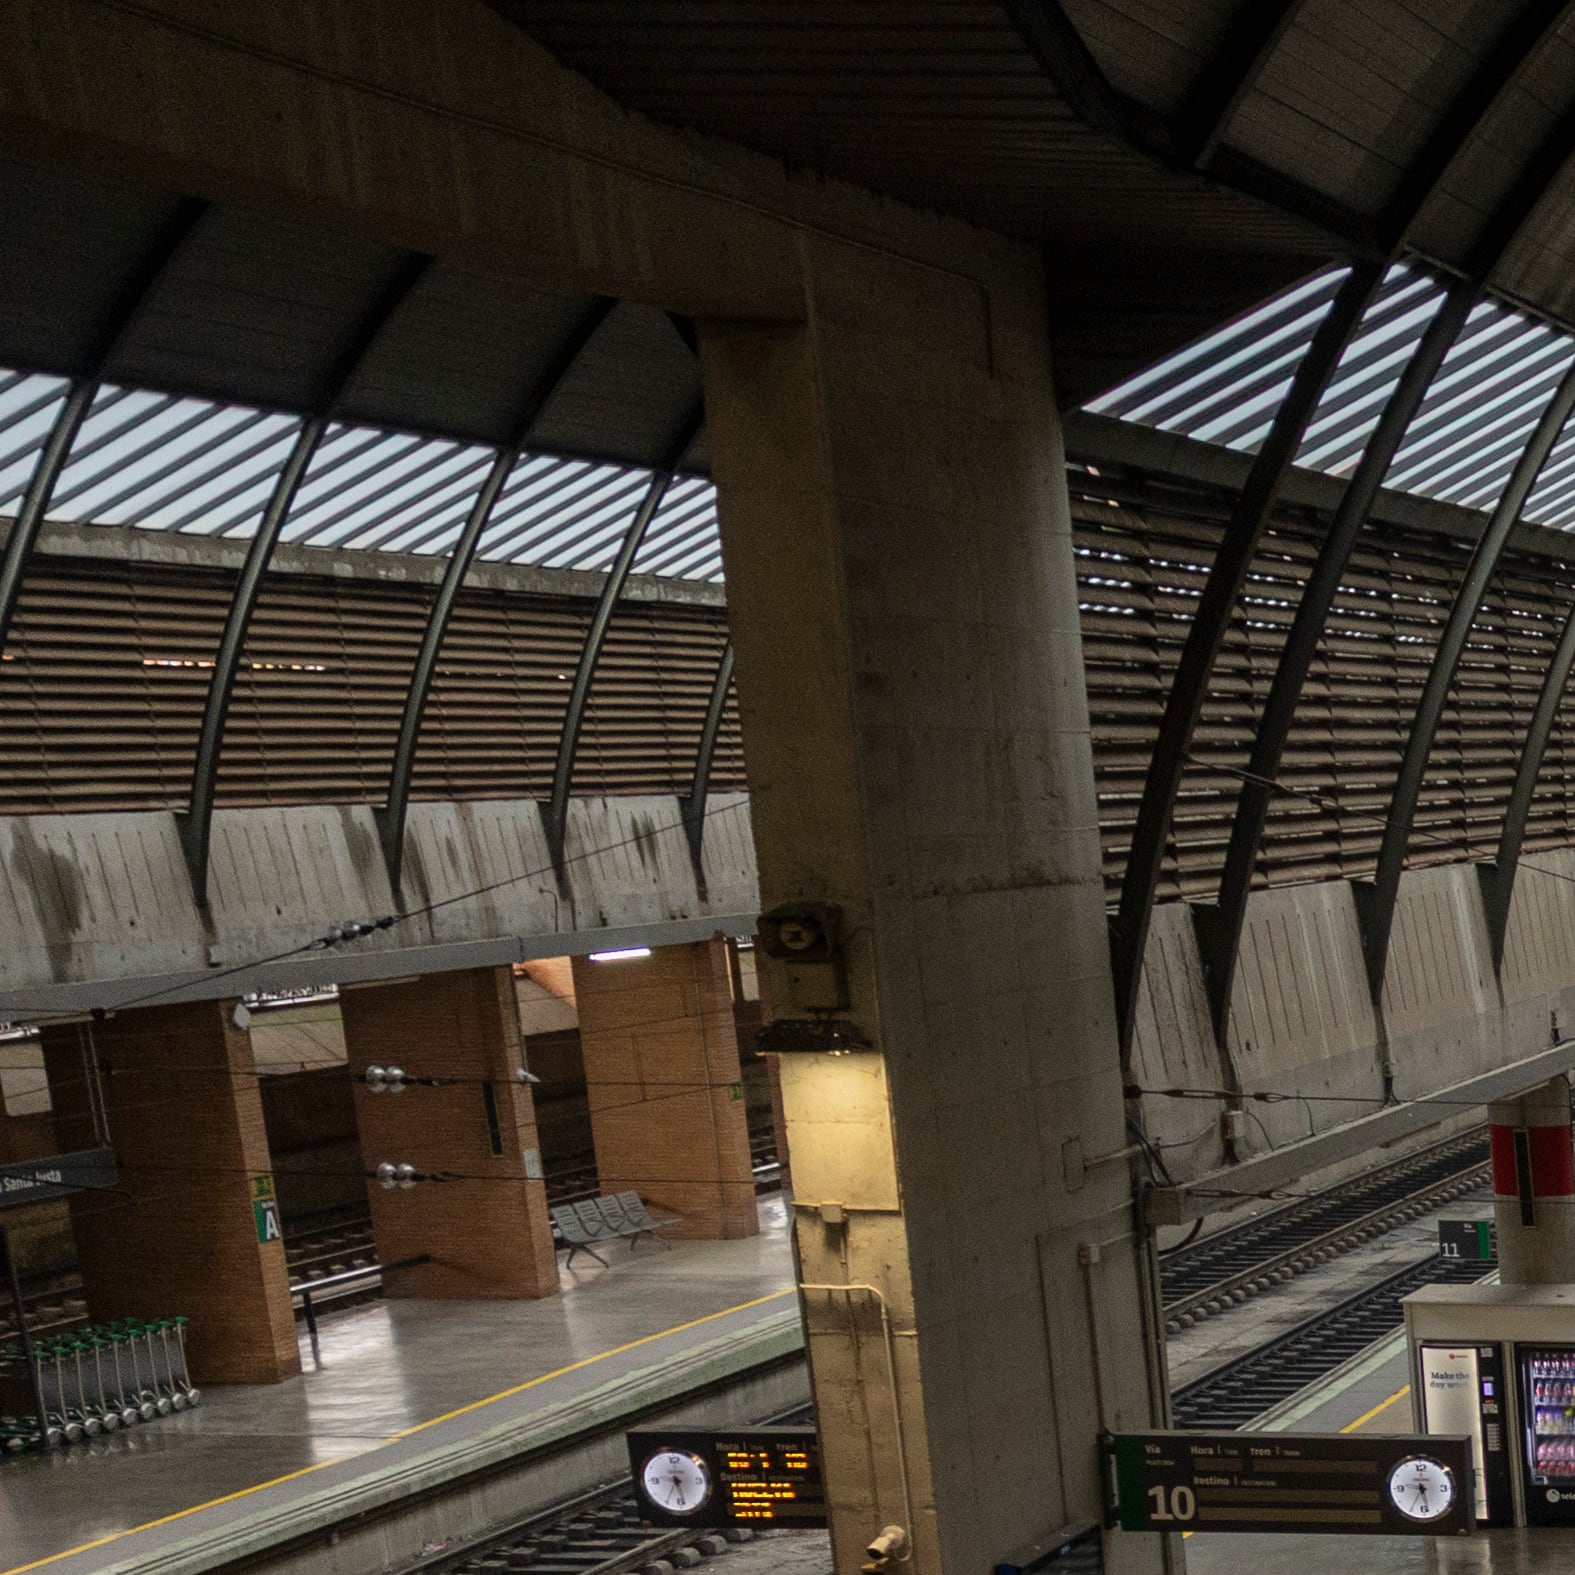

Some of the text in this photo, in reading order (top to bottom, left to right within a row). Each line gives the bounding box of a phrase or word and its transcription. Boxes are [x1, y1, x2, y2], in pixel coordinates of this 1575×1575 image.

[265, 1210, 281, 1240] A
[1442, 1242, 1460, 1257] 11
[1431, 1371, 1455, 1380] Make
[1144, 1444, 1161, 1454] Vía
[1190, 1445, 1214, 1455] Hora
[1250, 1447, 1271, 1456] Tren
[669, 1456, 680, 1465] 12
[1415, 1464, 1427, 1472] 12
[652, 1477, 660, 1485] 9
[695, 1477, 703, 1485] 3
[1193, 1476, 1229, 1486] Destino
[1397, 1485, 1404, 1493] 9
[1440, 1484, 1448, 1493] 3
[1147, 1485, 1196, 1521] 10
